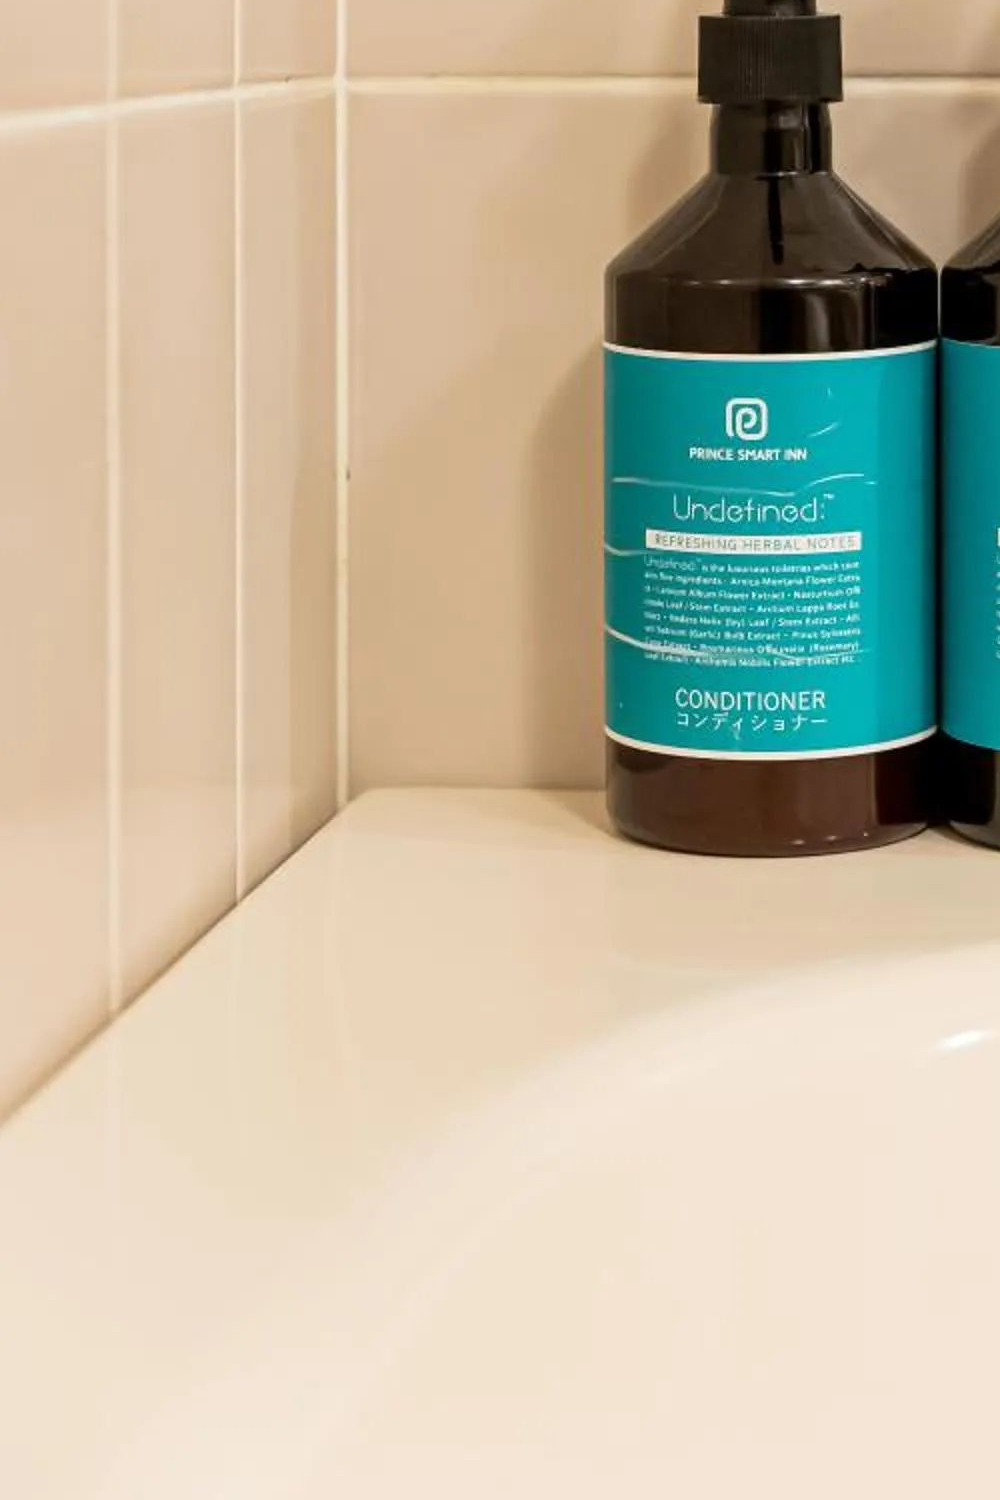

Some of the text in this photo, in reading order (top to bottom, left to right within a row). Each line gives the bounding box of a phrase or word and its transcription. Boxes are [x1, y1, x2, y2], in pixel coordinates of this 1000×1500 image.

[689, 447, 808, 461] PRINCE SMART INN
[655, 533, 856, 552] REFRESHING HERBAL NOTES
[675, 688, 826, 711] CONDITIONER
